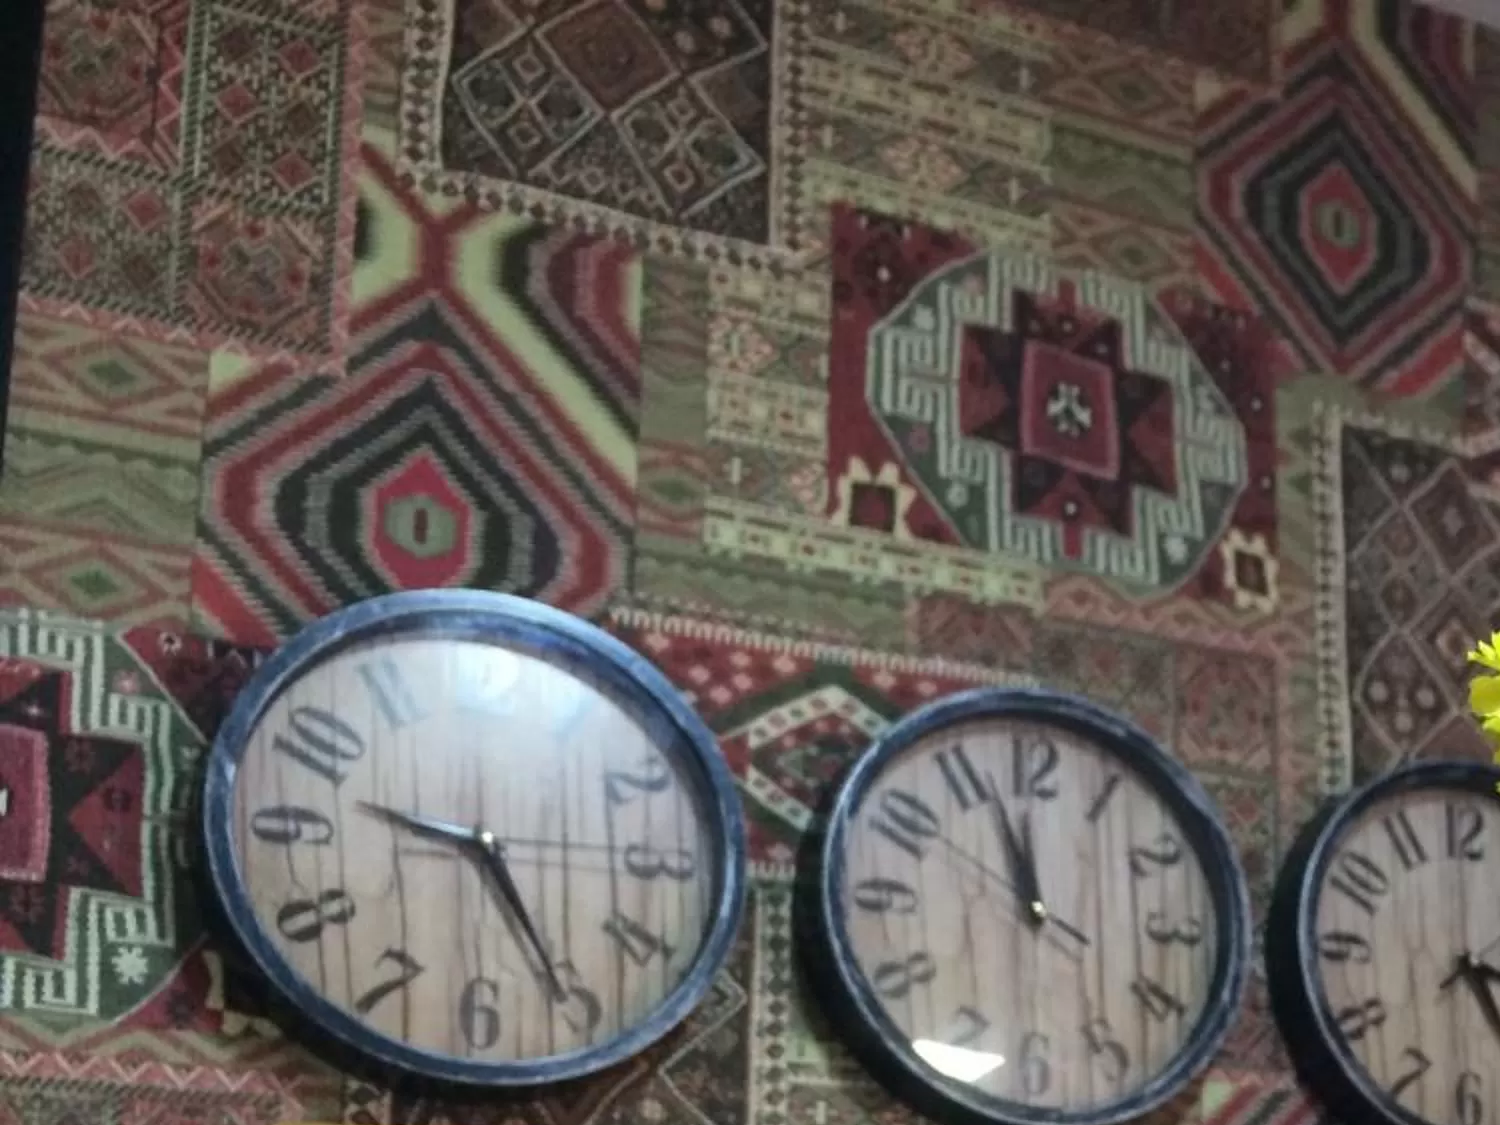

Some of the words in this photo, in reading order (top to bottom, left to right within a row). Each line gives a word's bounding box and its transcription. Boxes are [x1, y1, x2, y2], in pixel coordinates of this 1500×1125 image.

[357, 655, 431, 731] 11
[273, 705, 366, 786] 10
[1011, 733, 1060, 801] 12
[604, 754, 671, 805] 2
[934, 744, 990, 811] 11
[1086, 772, 1121, 823] 1
[250, 805, 334, 846] 9
[869, 788, 941, 861] 10
[1383, 810, 1429, 872] 11
[1445, 803, 1486, 862] 12
[623, 843, 696, 883] 3
[1128, 831, 1183, 878] 2
[853, 876, 917, 914] 9
[1329, 851, 1389, 916] 10
[277, 889, 356, 943] 8
[602, 911, 676, 967] 4
[1146, 911, 1202, 948] 3
[874, 951, 937, 999] 8
[1320, 931, 1371, 965] 9
[354, 947, 426, 1015] 7
[553, 958, 602, 1034] 5
[1129, 975, 1186, 1022] 4
[459, 976, 500, 1050] 6
[943, 1006, 991, 1048] 7
[1338, 997, 1388, 1042] 8
[1018, 1031, 1051, 1095] 6
[1081, 1018, 1130, 1083] 5
[1391, 1046, 1432, 1098] 7
